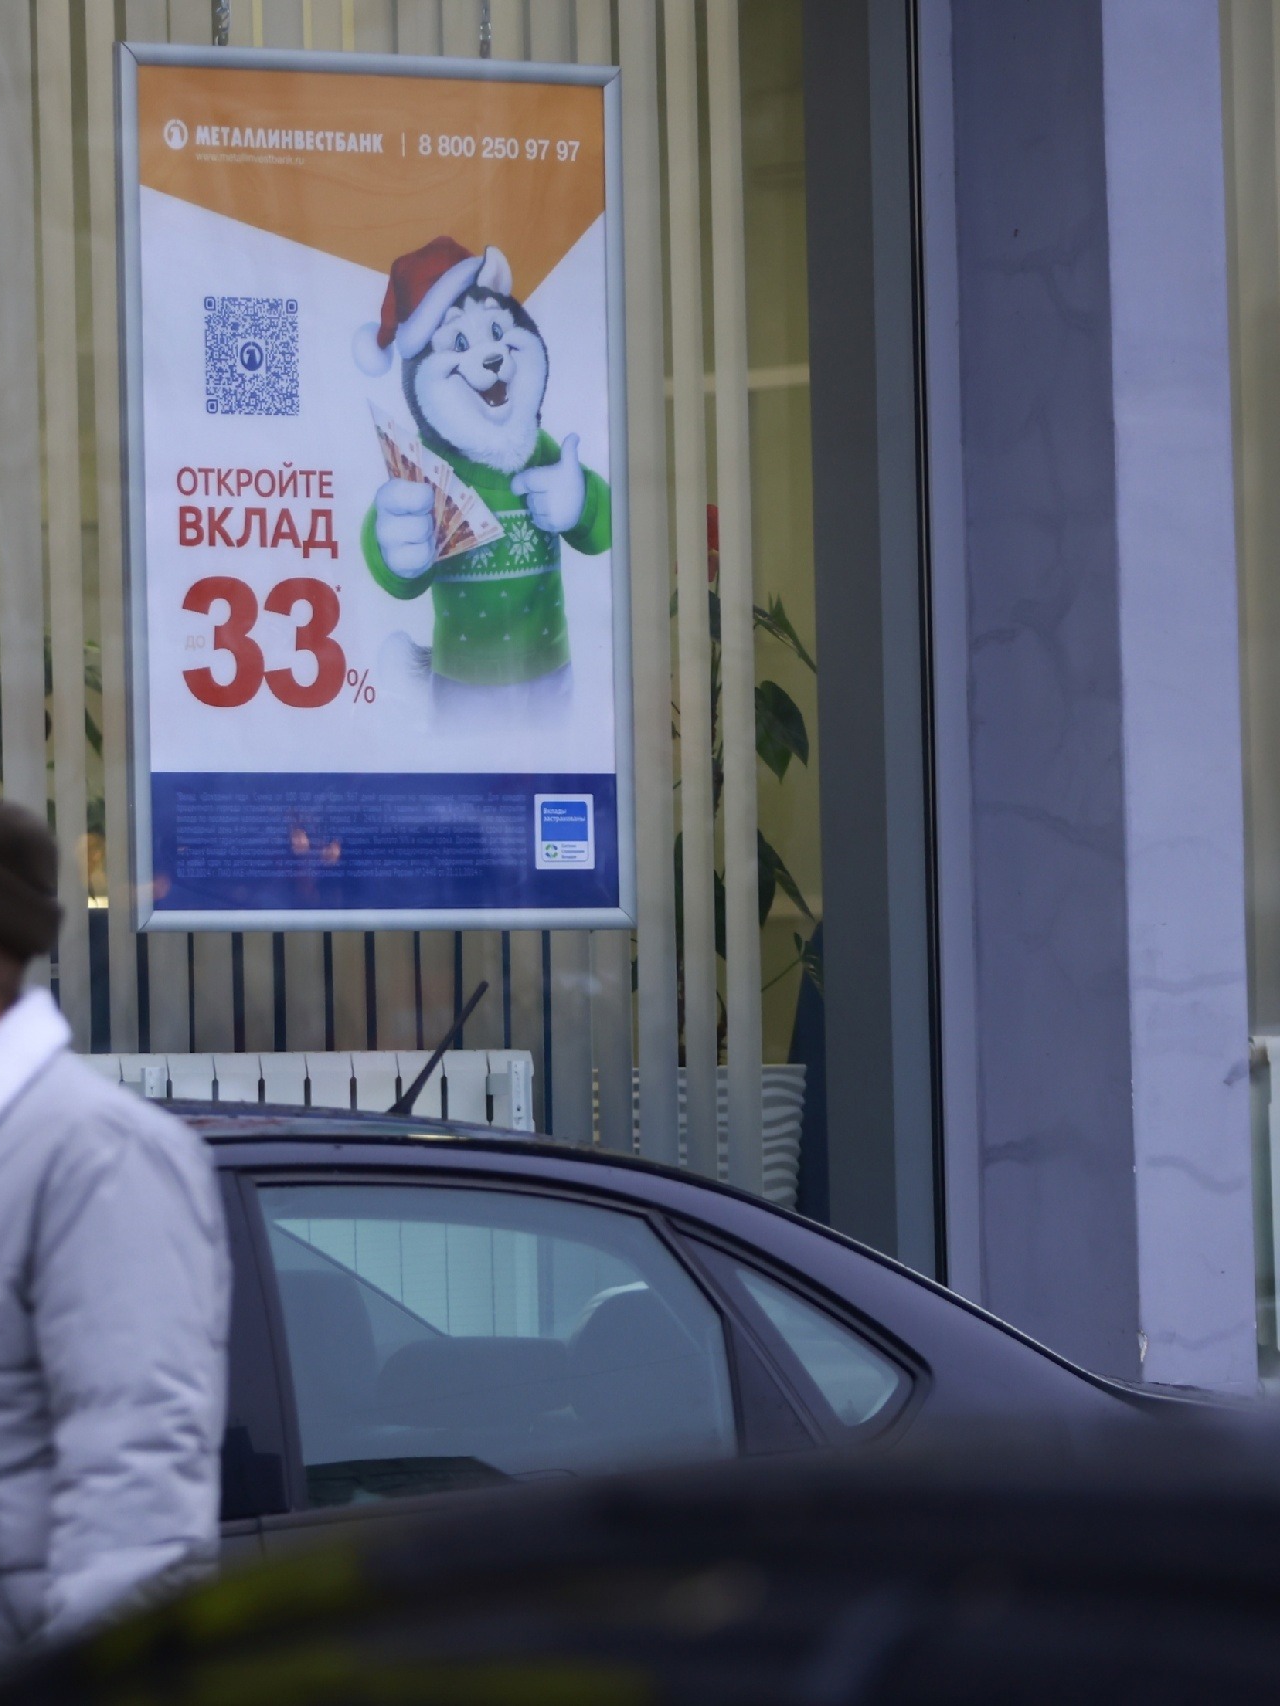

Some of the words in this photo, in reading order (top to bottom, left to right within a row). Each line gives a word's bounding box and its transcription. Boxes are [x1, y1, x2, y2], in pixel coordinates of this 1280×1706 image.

[195, 125, 384, 154] МЕТАЛЛИНВЕСТБАНК
[419, 133, 432, 155] 8
[438, 135, 475, 158] 800
[482, 137, 519, 159] 250
[525, 138, 550, 160] 97
[557, 140, 581, 162] 97
[176, 461, 334, 499] ОТКРОЙТЕ
[179, 505, 339, 559] ВКЛАД
